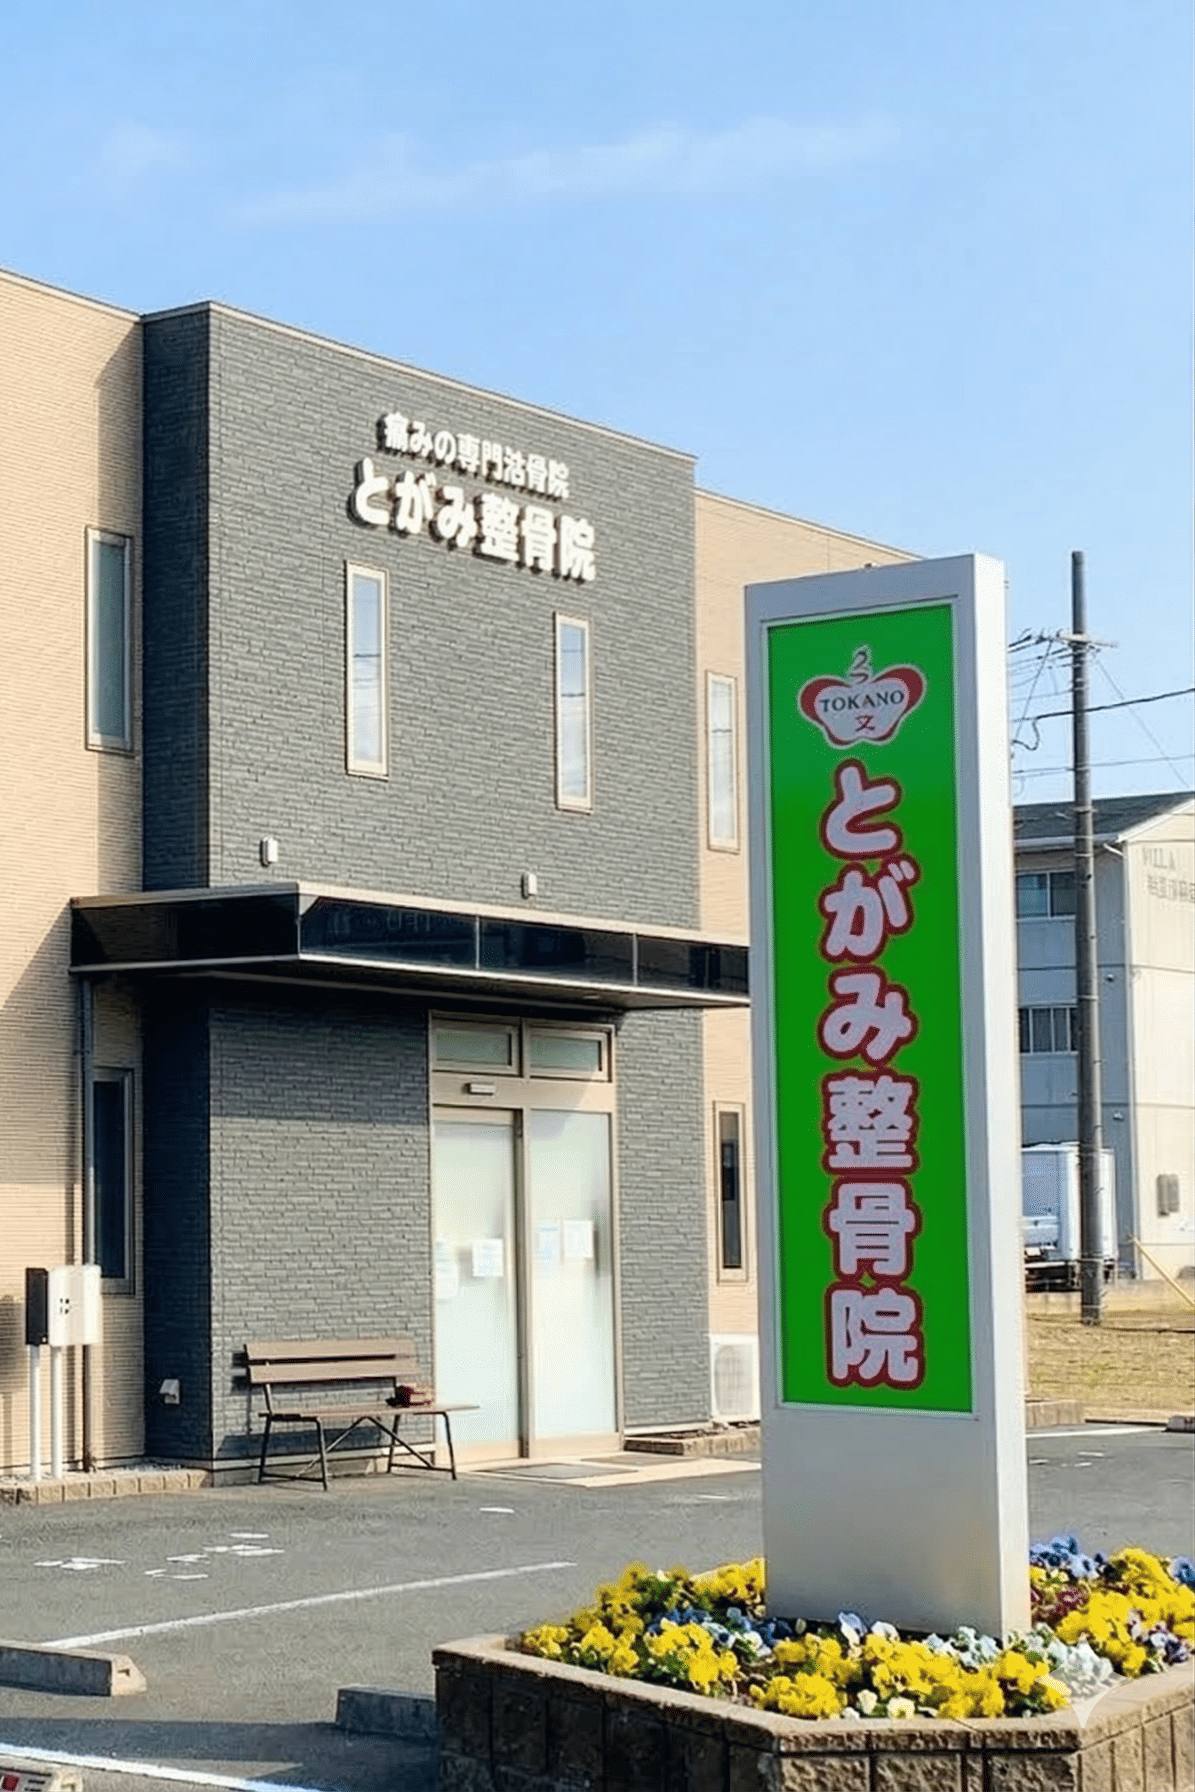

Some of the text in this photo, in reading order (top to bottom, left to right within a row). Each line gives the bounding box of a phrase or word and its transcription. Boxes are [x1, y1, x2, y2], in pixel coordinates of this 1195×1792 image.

[354, 457, 597, 581] とがみ整骨院
[819, 690, 905, 713] TOKANO
[818, 758, 924, 1389] とがみ整骨院
